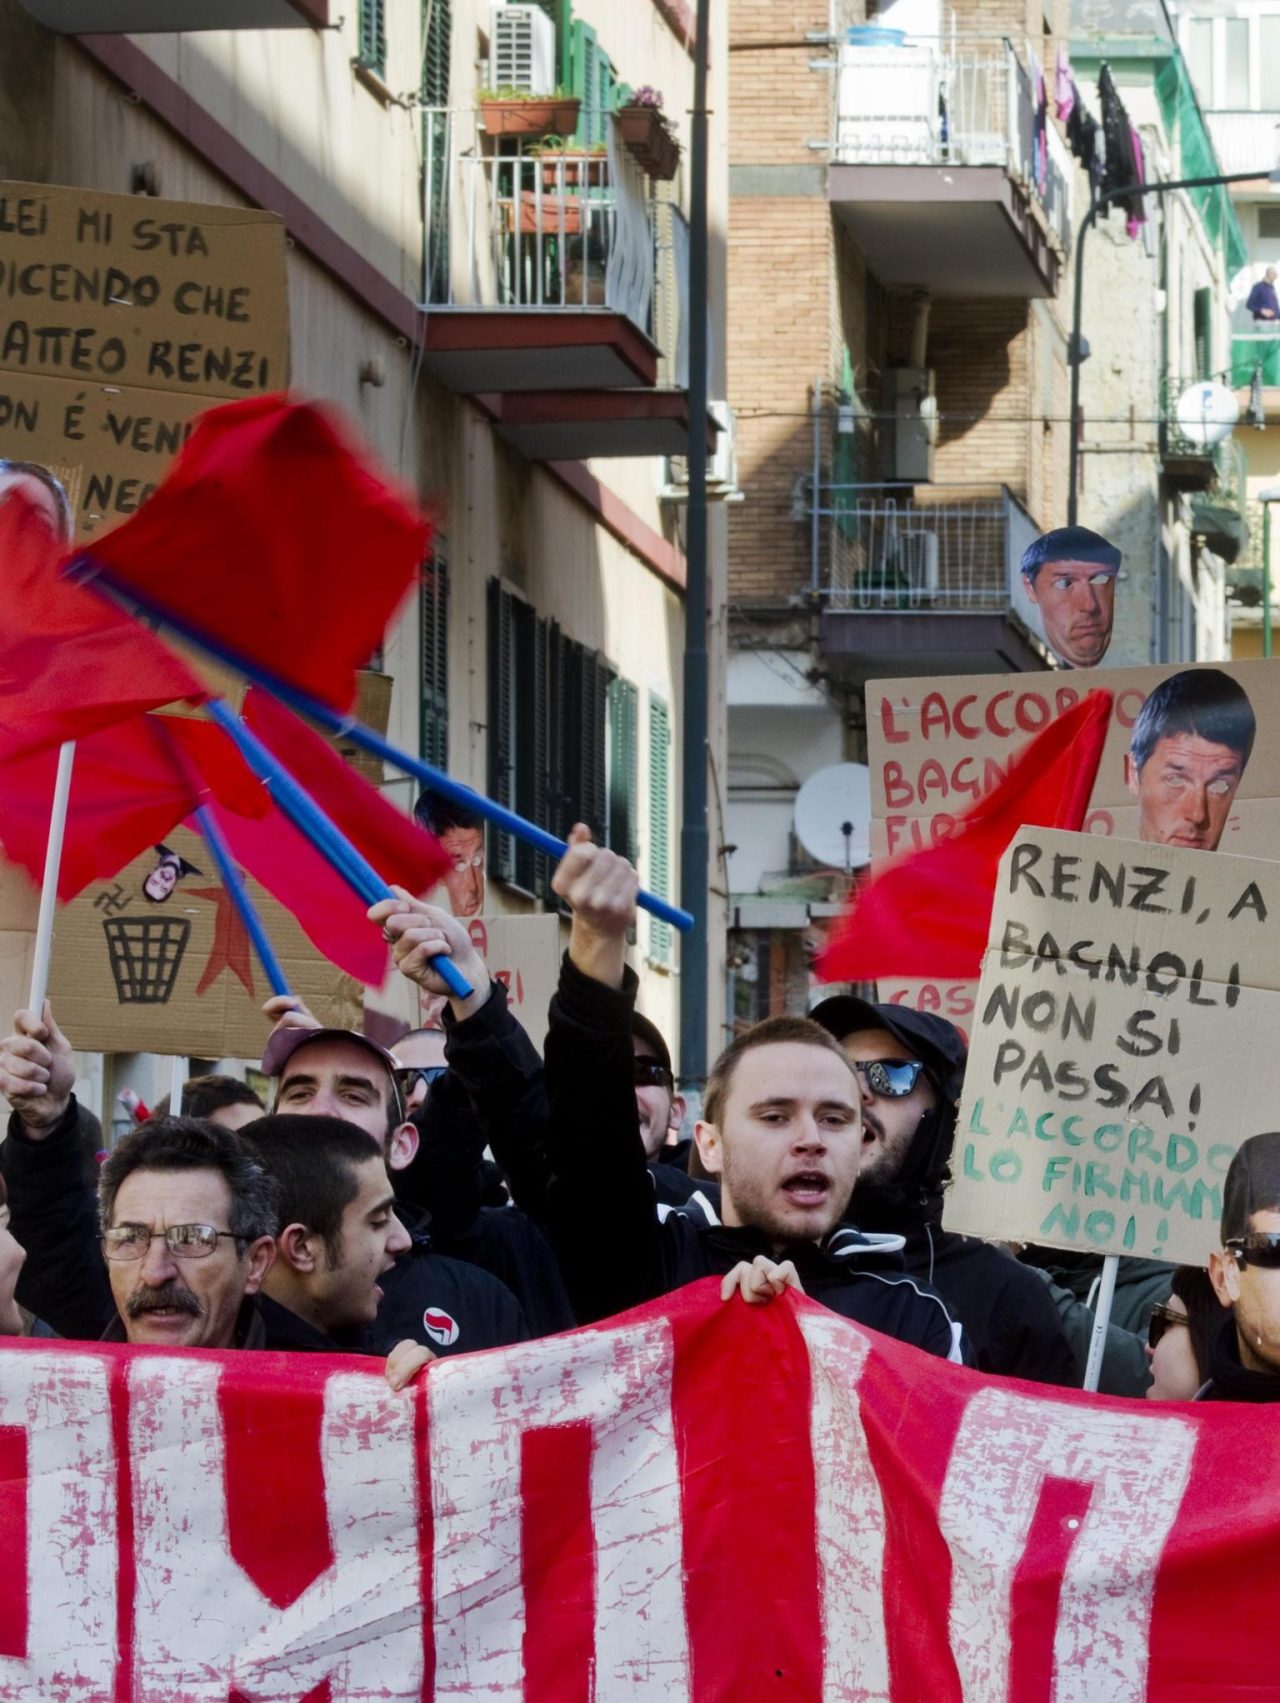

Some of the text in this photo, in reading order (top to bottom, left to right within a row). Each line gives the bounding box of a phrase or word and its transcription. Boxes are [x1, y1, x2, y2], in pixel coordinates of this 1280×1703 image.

[0, 198, 209, 257] LEI MI STA
[0, 258, 251, 323] ICENDO CHE
[2, 320, 270, 389] ATTEO RENZI
[0, 395, 38, 432] ON
[1009, 843, 1270, 924] RENZI, A
[1000, 920, 1241, 1009] BAGNOLI
[982, 983, 1097, 1042] NON
[1116, 1009, 1181, 1057] SI
[993, 1039, 1201, 1133] PASSA!
[963, 1142, 1222, 1222] LO FIRMIAM
[1039, 1203, 1169, 1256] NOI!
